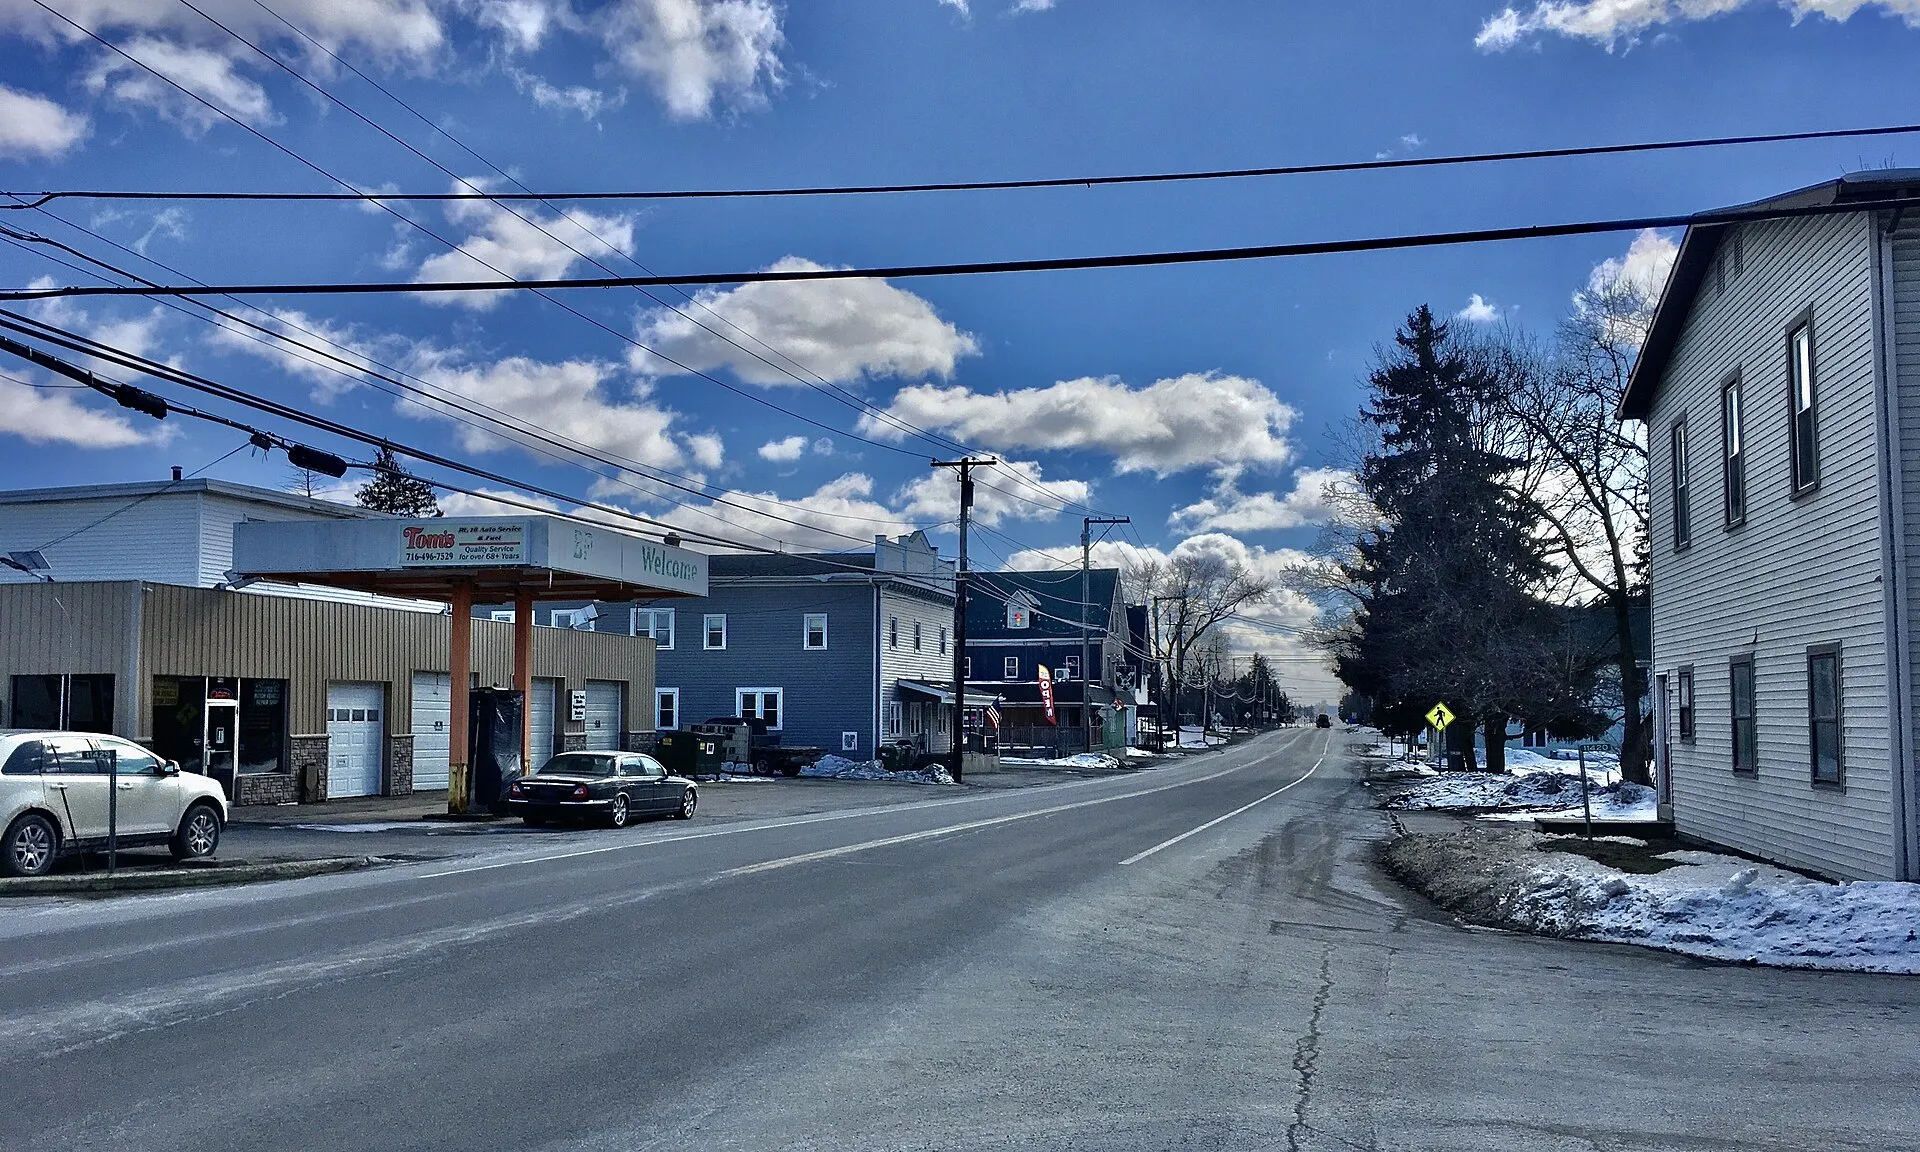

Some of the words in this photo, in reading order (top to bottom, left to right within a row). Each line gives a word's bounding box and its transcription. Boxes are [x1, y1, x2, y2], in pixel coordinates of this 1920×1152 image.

[403, 527, 456, 549] Tom's
[464, 546, 488, 554] Quality
[489, 545, 515, 553] Service
[406, 552, 454, 561] 716-496-7529
[641, 545, 698, 581] Welcome
[85, 751, 111, 759] 11429
